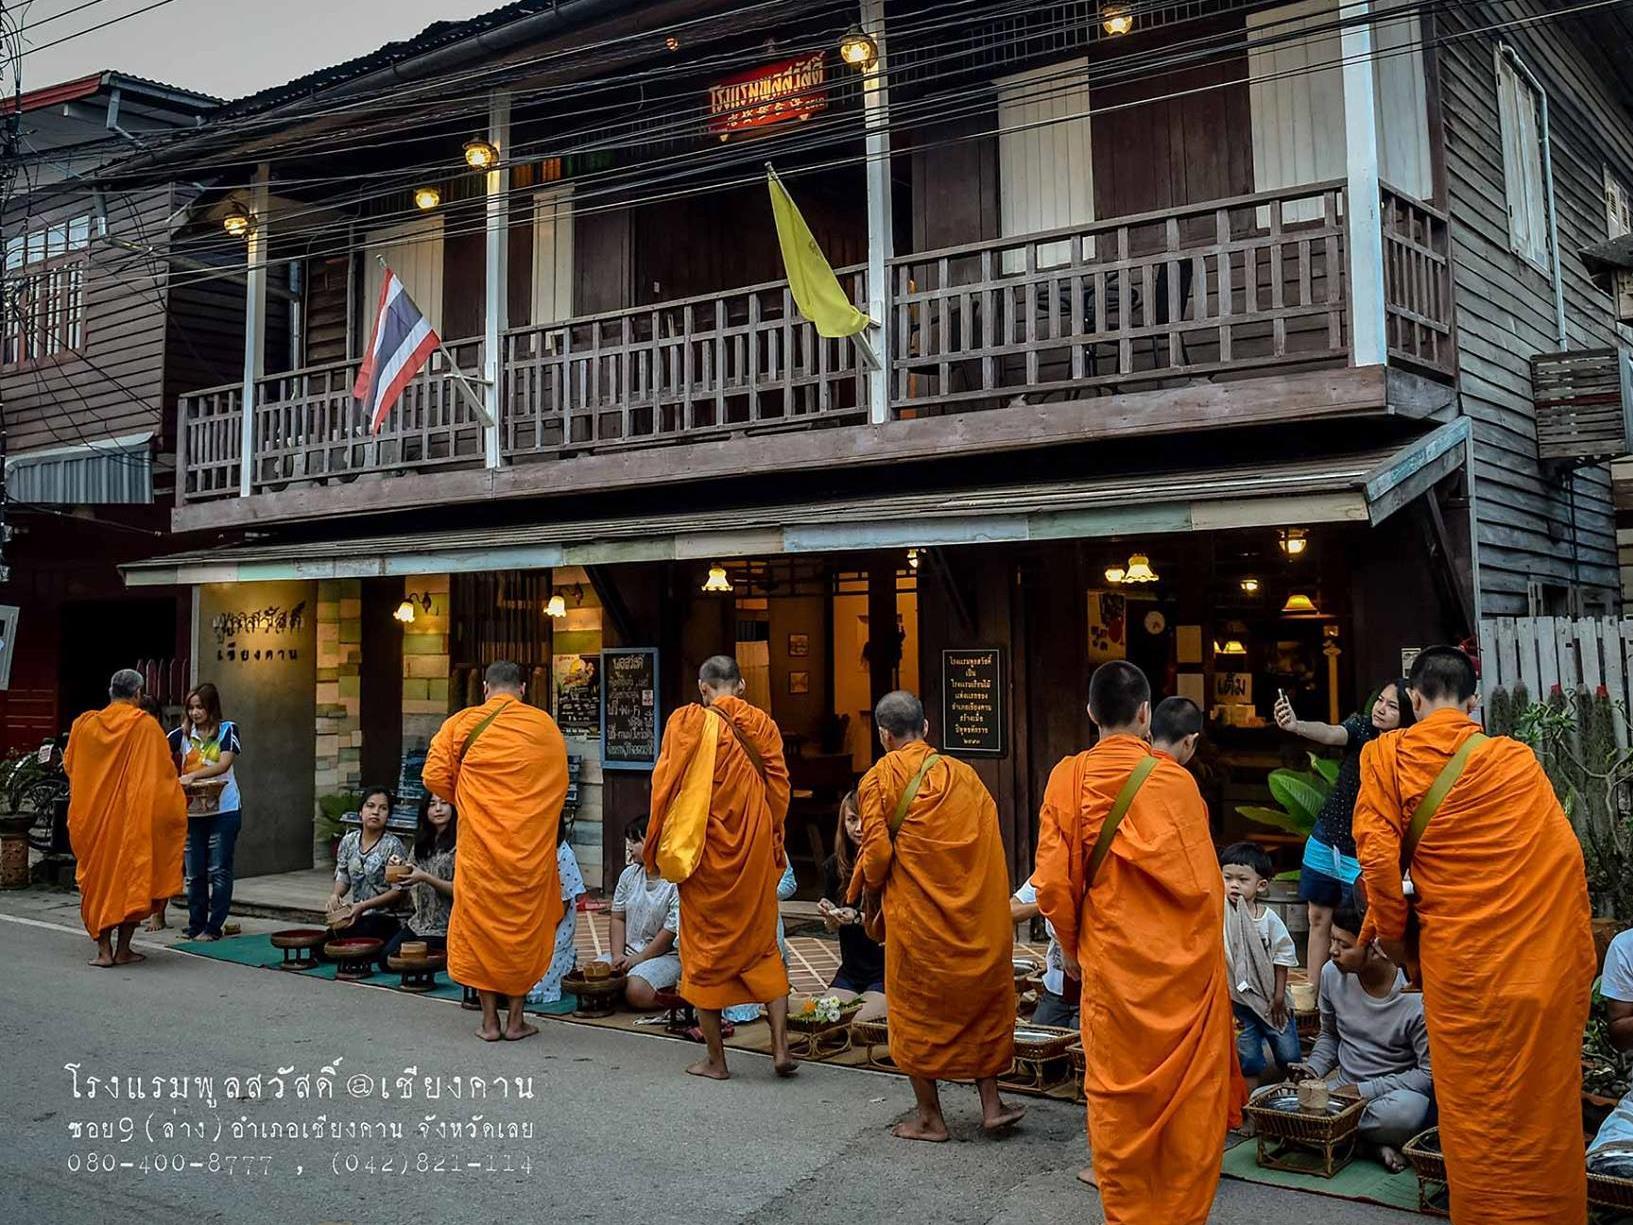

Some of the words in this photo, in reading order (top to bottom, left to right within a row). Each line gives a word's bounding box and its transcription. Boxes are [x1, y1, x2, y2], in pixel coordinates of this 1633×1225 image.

[217, 642, 297, 661] เชียงคาน
[1217, 672, 1246, 697] เต็ม
